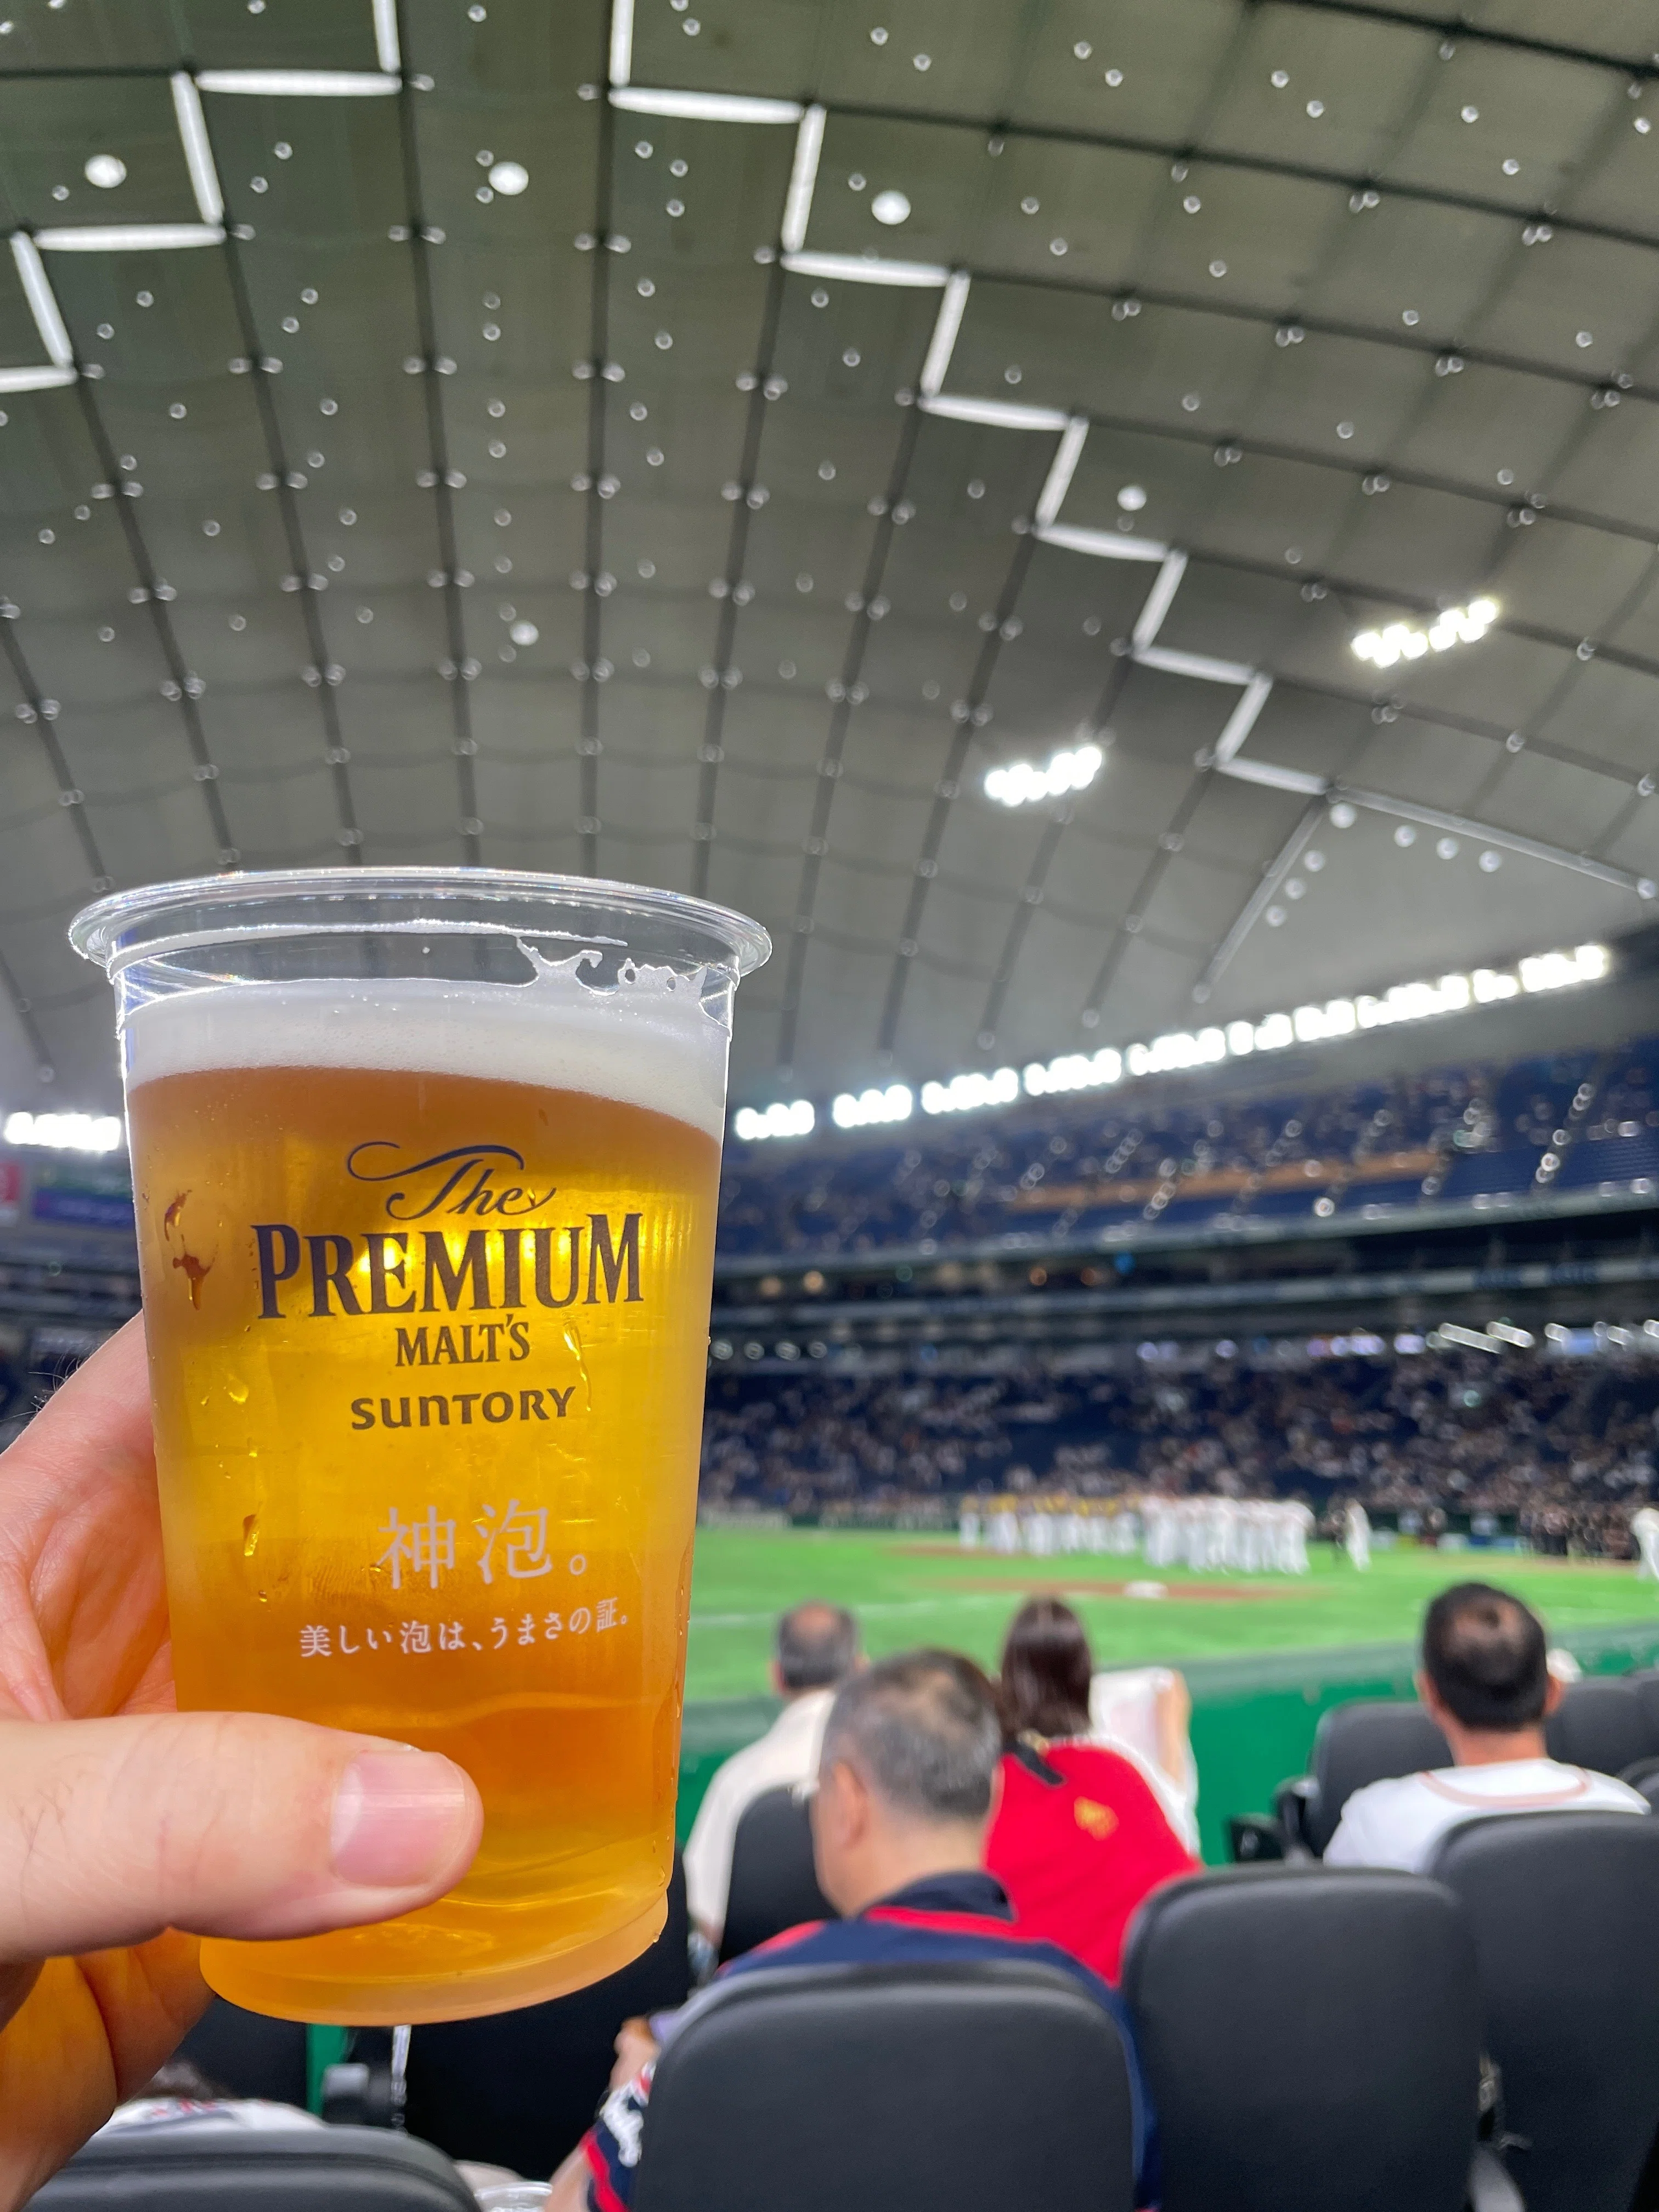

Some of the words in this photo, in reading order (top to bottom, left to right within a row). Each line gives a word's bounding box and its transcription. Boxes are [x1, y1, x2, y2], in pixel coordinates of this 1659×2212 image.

[347, 1141, 557, 1221] The
[250, 1212, 645, 1319] PREMIUM
[395, 1314, 531, 1368] MALT'S
[300, 1596, 629, 1657] 美しい泡は、うまさの証。
